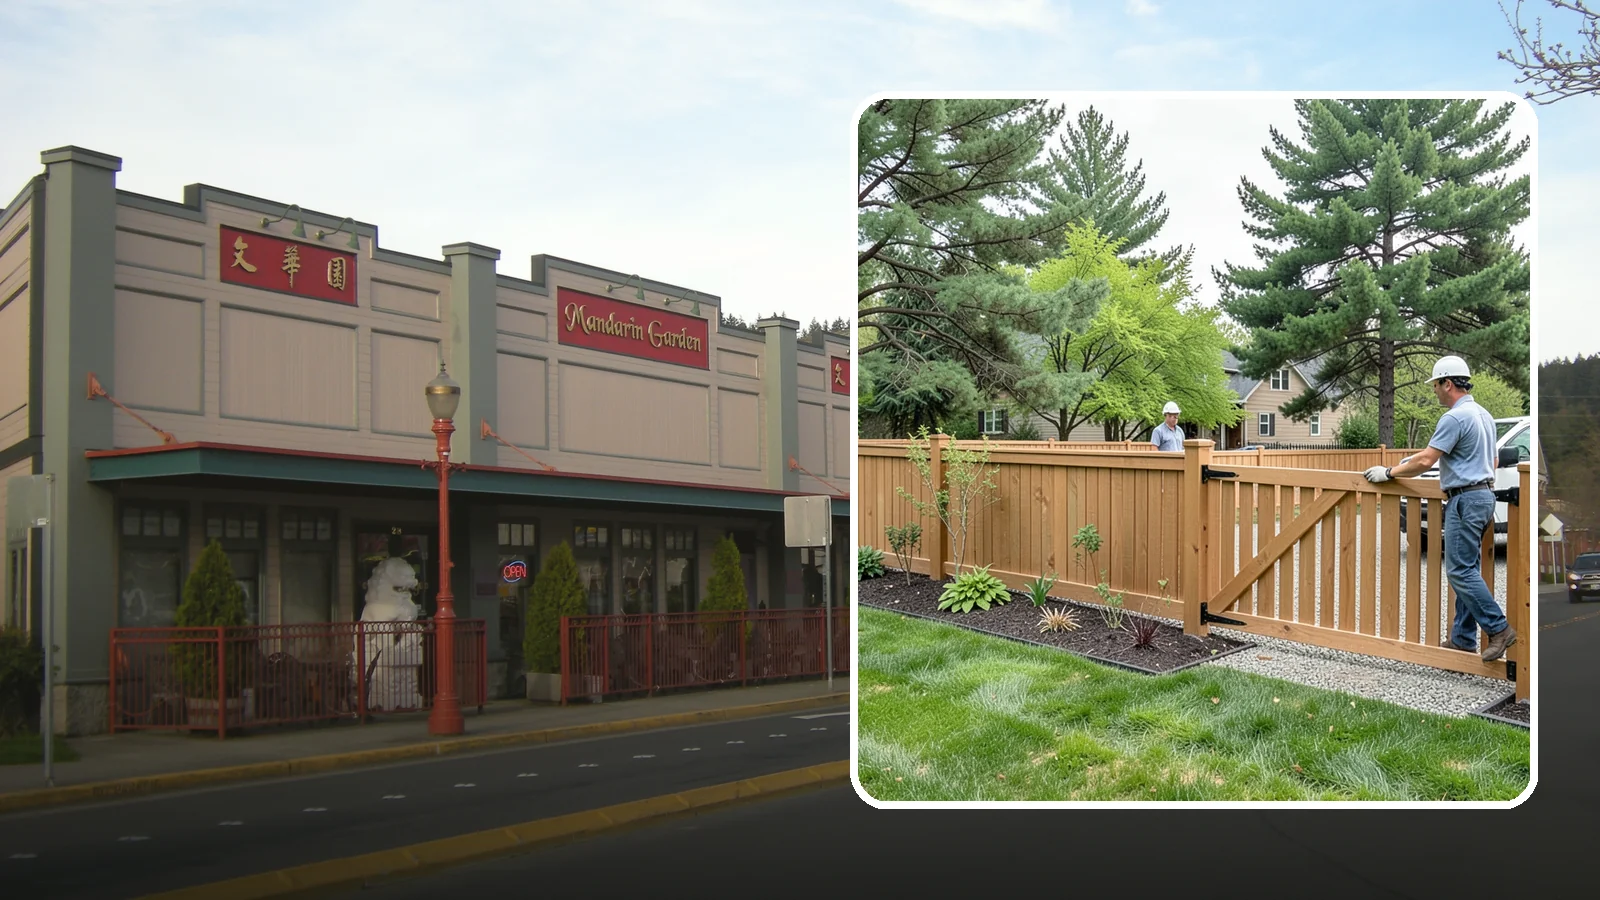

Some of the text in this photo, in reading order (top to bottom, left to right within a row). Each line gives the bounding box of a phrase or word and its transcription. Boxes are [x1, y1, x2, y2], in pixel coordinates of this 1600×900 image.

[230, 235, 346, 291] 文華園
[564, 302, 702, 352] Mandarin Garden
[503, 565, 527, 578] OPEN
